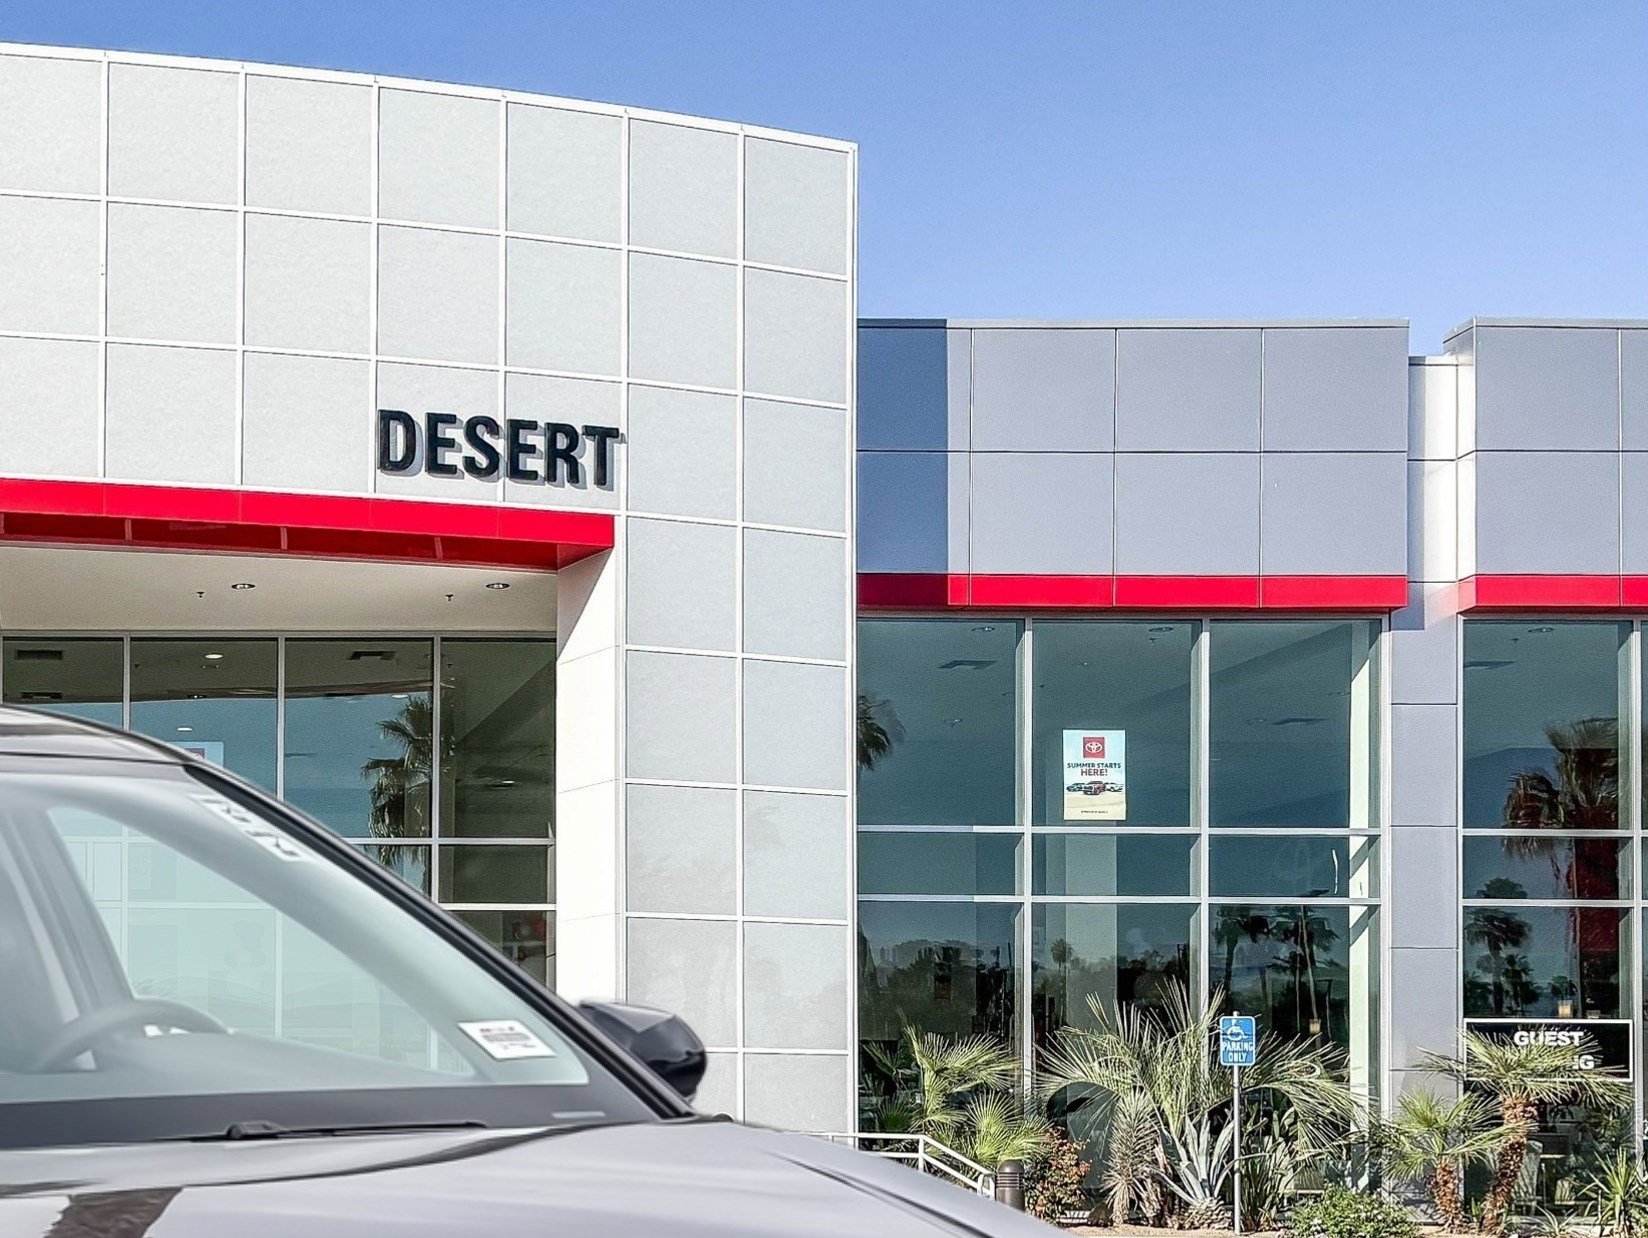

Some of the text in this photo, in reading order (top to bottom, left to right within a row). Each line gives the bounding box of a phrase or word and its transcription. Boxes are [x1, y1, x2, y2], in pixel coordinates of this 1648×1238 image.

[377, 409, 620, 486] DESERT
[1080, 768, 1108, 776] HERE!
[1513, 1030, 1585, 1046] GUEST
[1222, 1041, 1254, 1052] PARKING
[1228, 1052, 1248, 1062] ONLY
